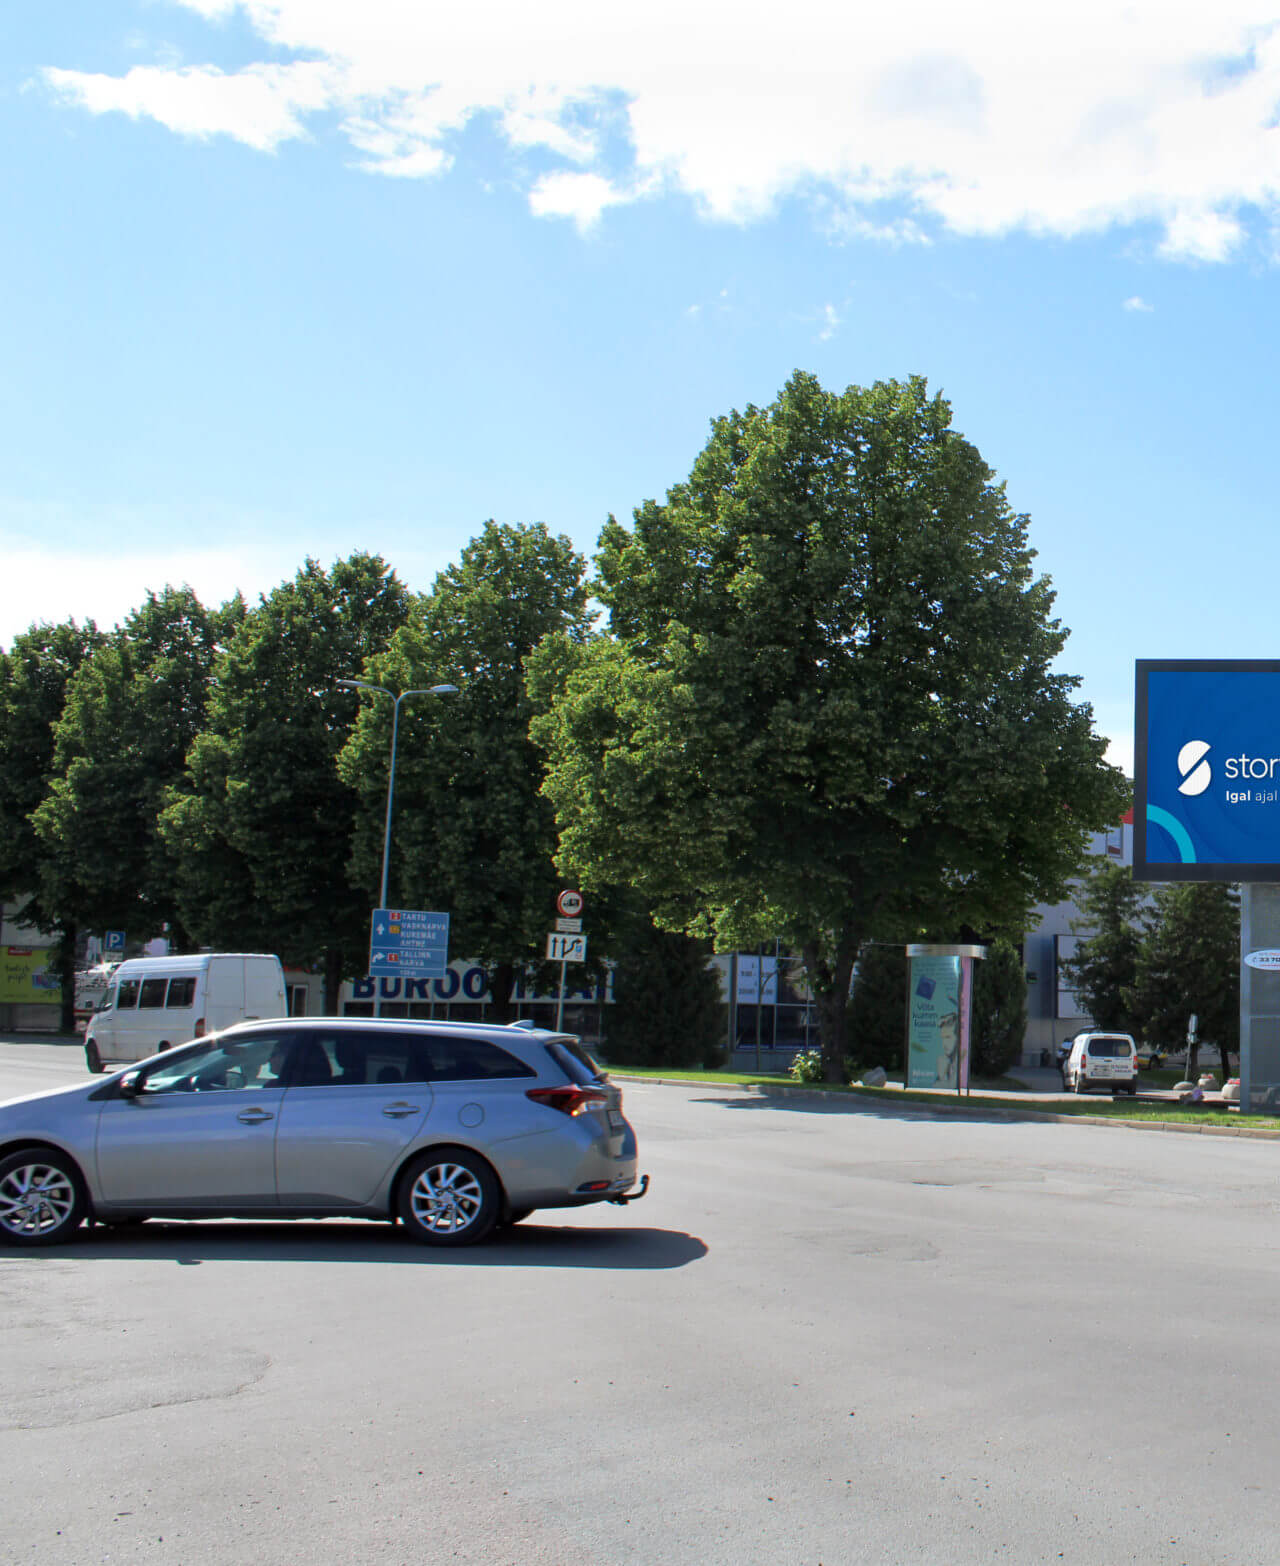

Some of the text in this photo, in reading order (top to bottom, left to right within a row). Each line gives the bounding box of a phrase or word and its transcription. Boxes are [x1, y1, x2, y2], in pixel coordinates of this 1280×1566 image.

[1226, 790, 1251, 803] Igal
[1255, 790, 1278, 803] ajal
[401, 912, 427, 921] TARTU
